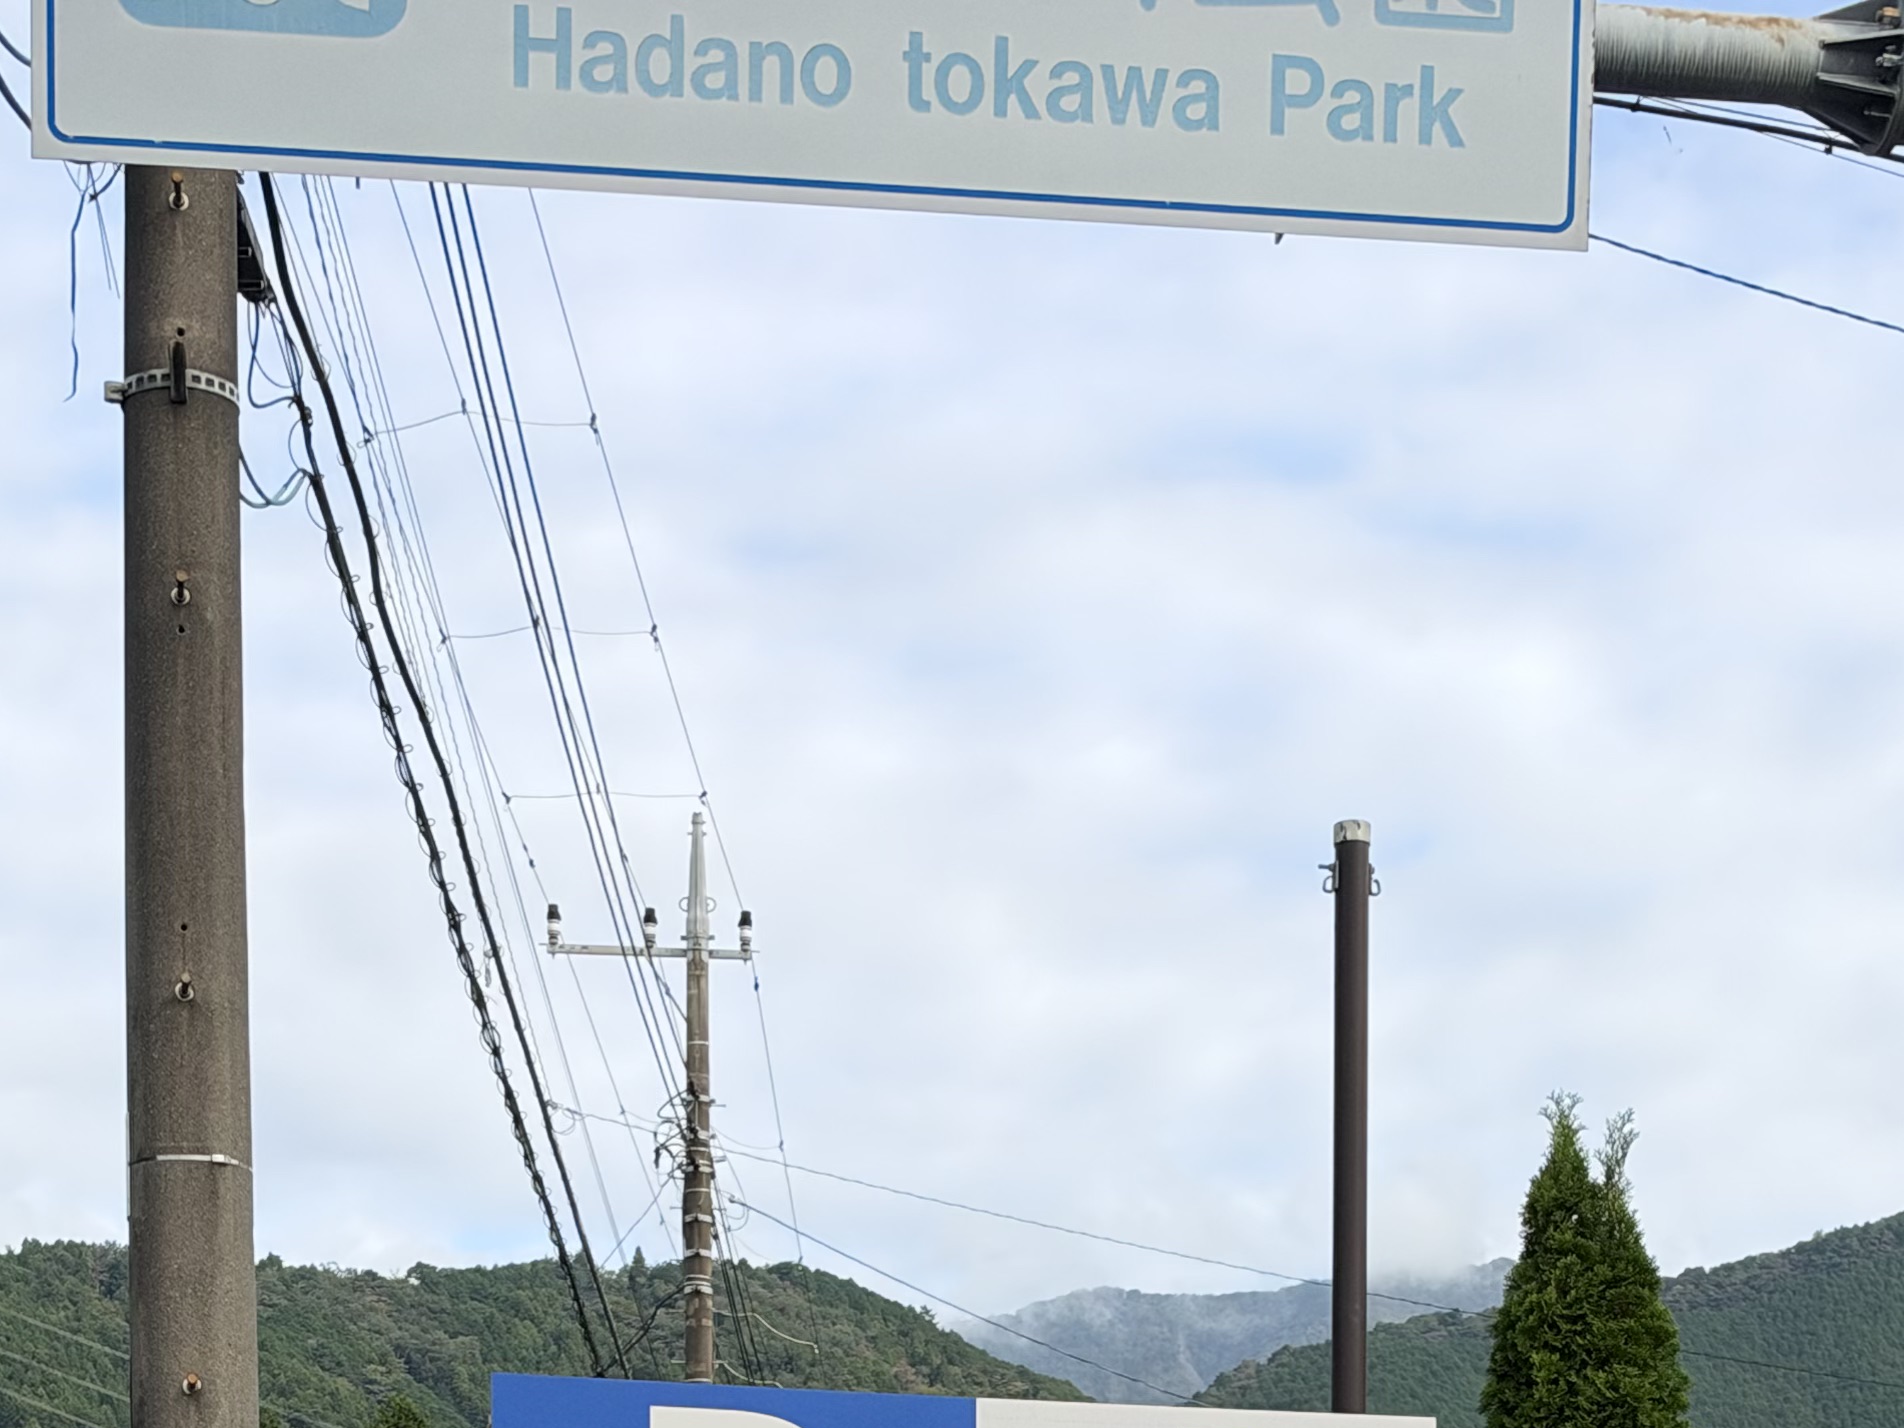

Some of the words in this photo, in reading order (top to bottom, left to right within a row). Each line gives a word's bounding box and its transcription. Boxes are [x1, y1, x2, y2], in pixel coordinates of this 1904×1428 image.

[513, 3, 852, 108] Hadano
[902, 30, 1220, 132] tokawa
[1269, 53, 1466, 149] Park
